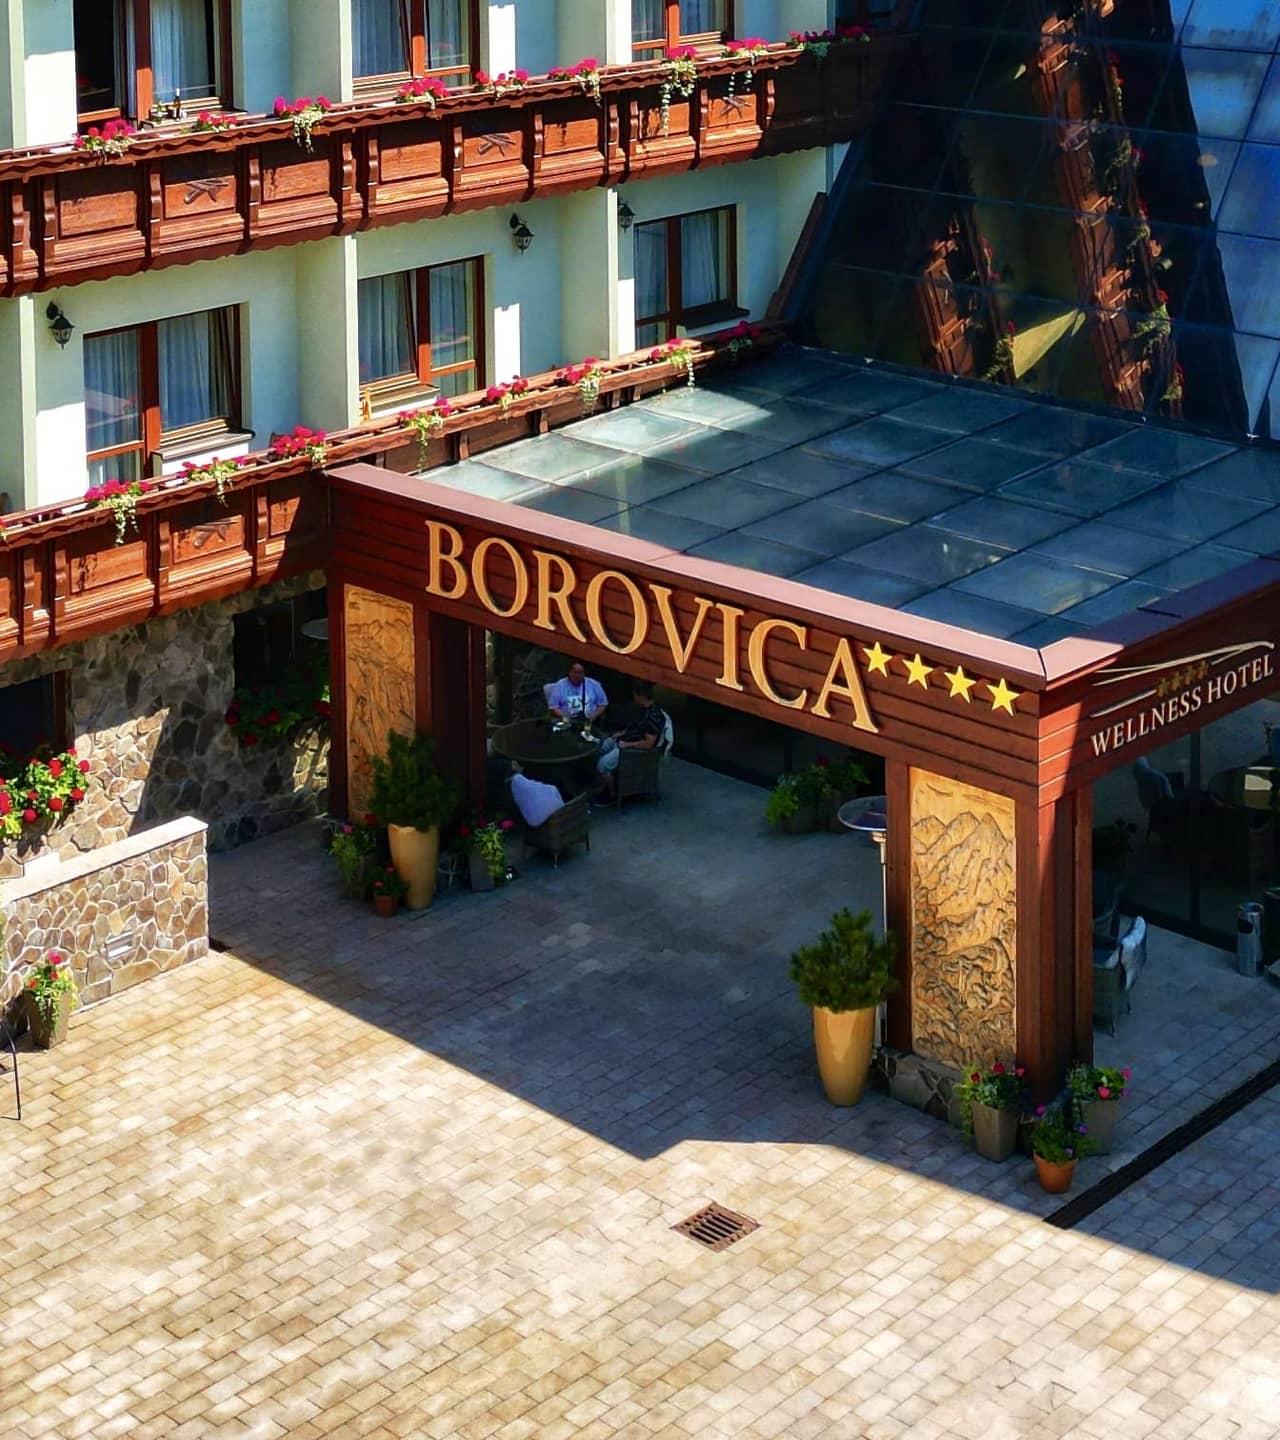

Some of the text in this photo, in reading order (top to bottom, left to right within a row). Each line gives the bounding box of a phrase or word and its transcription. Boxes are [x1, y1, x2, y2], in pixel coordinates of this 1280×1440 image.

[424, 520, 880, 734] BOROVICA
[1090, 653, 1275, 757] WELLNESS HOTEL
